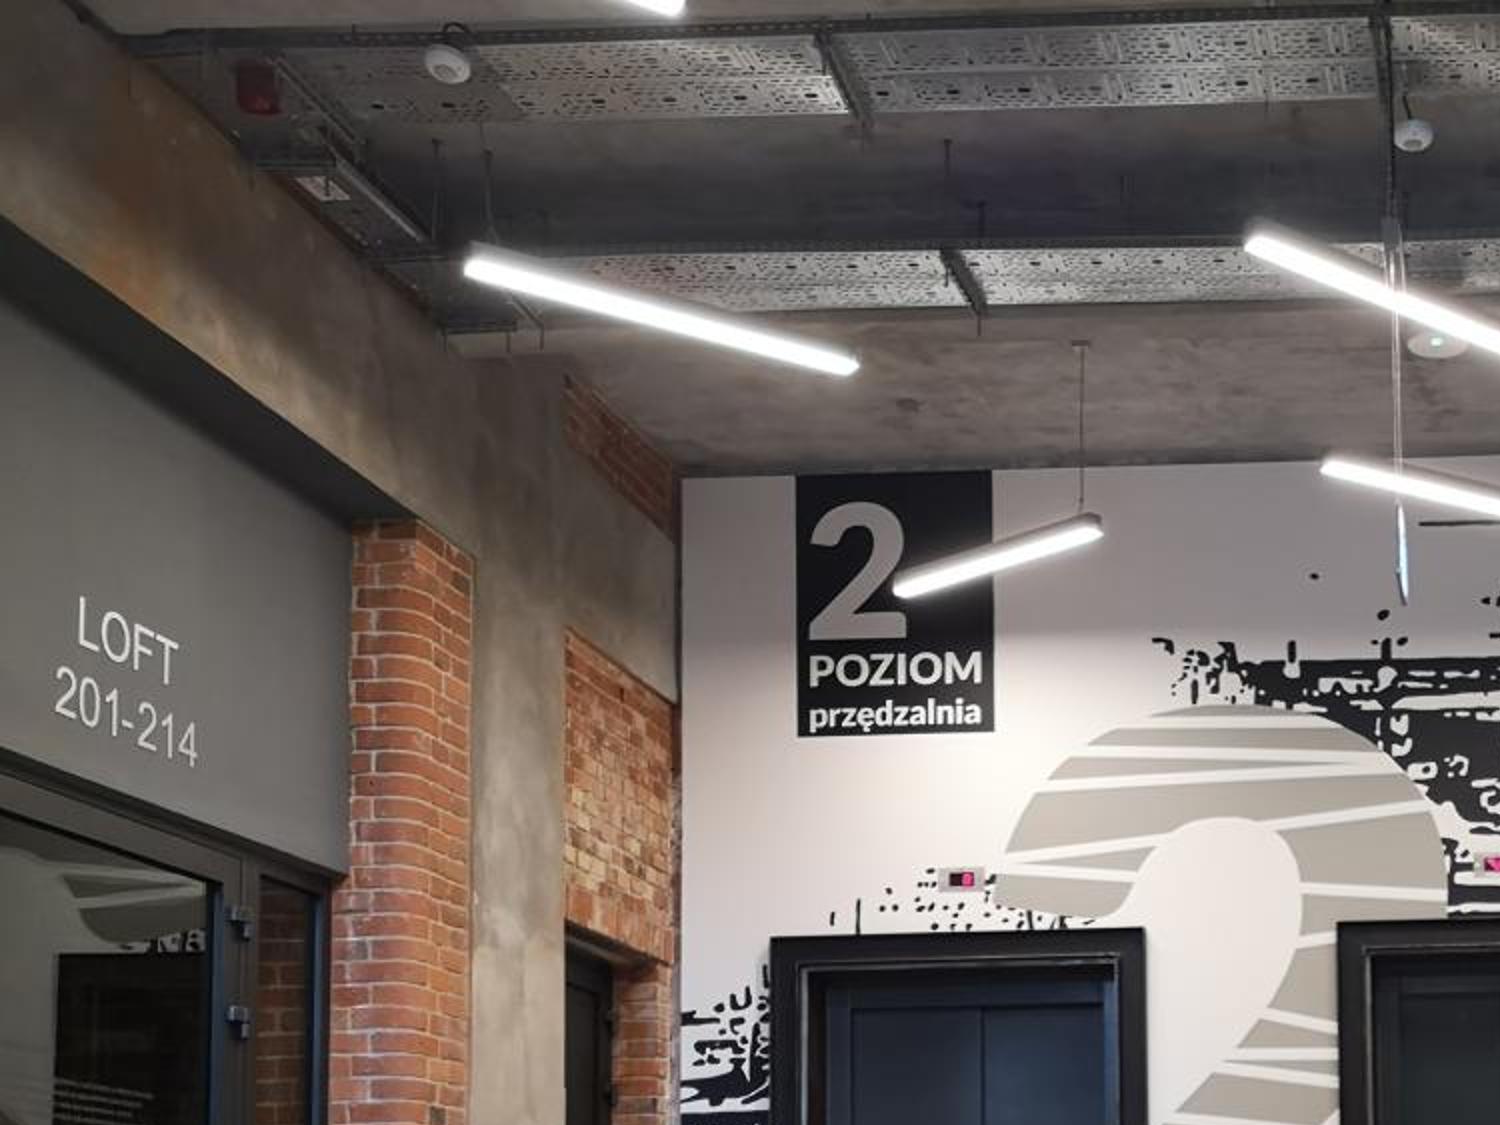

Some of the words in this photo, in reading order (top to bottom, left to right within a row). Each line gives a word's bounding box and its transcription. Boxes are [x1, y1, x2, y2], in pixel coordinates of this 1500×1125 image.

[809, 501, 907, 641] 2
[78, 595, 179, 685] LOFT
[809, 650, 983, 688] POZIOM
[54, 665, 198, 768] 201-214
[809, 697, 983, 733] przędzalnia
